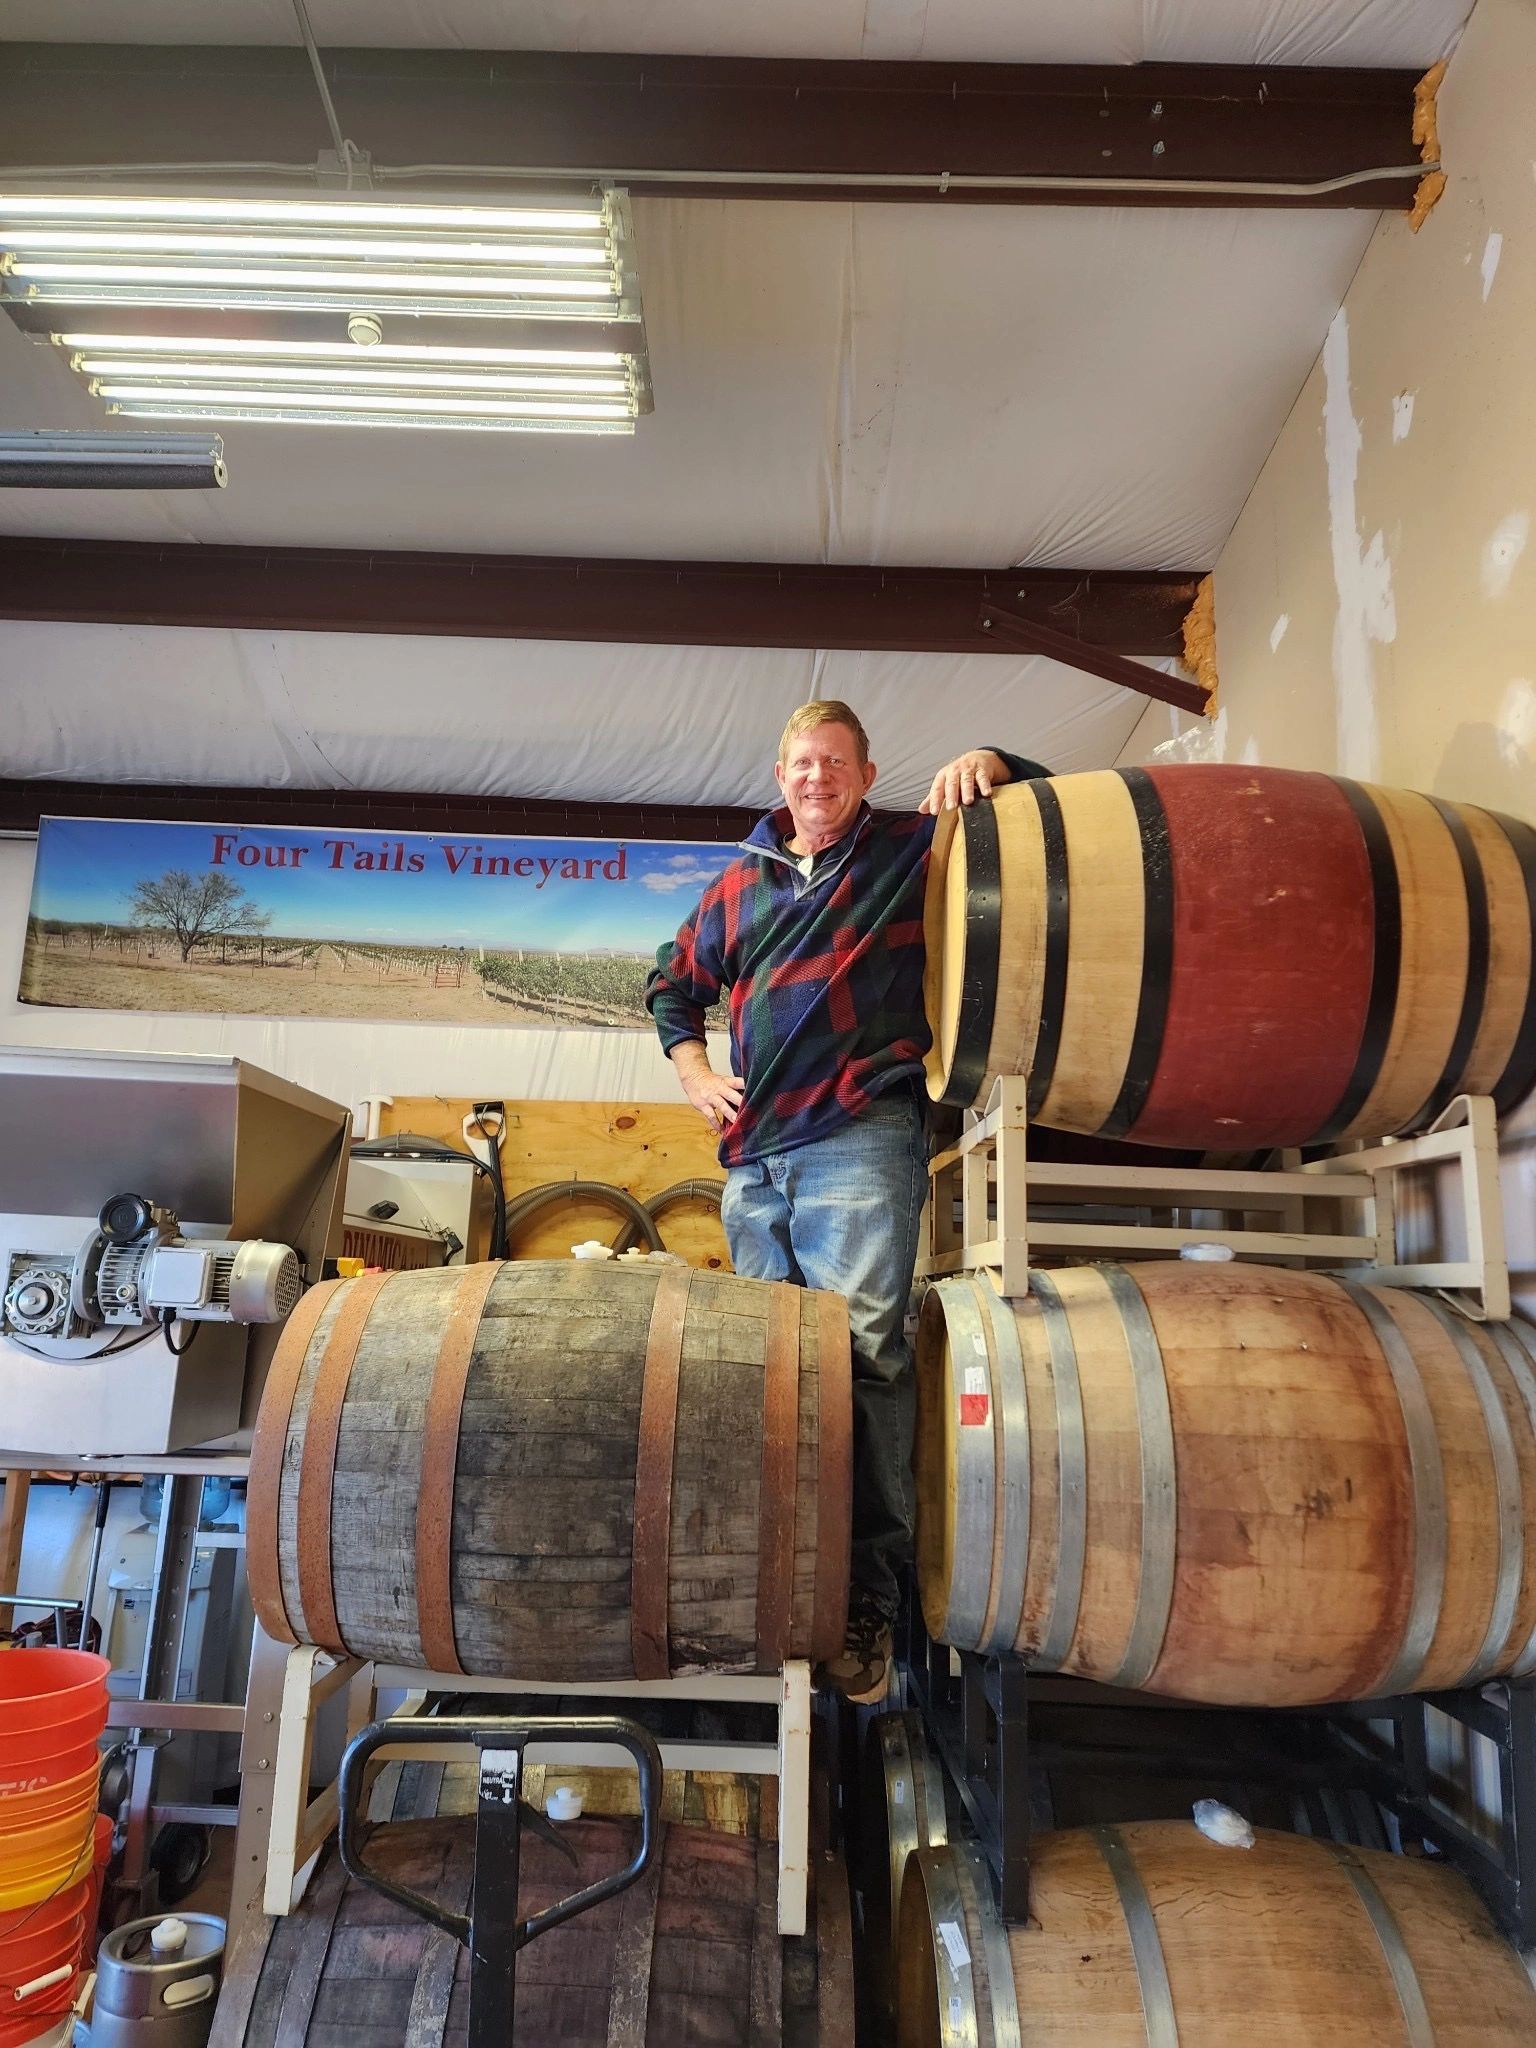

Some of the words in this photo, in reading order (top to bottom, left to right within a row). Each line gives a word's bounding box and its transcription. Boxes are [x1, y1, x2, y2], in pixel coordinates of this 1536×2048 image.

[209, 834, 309, 868] Four
[323, 839, 423, 873] Tails
[440, 845, 629, 889] Vineyard
